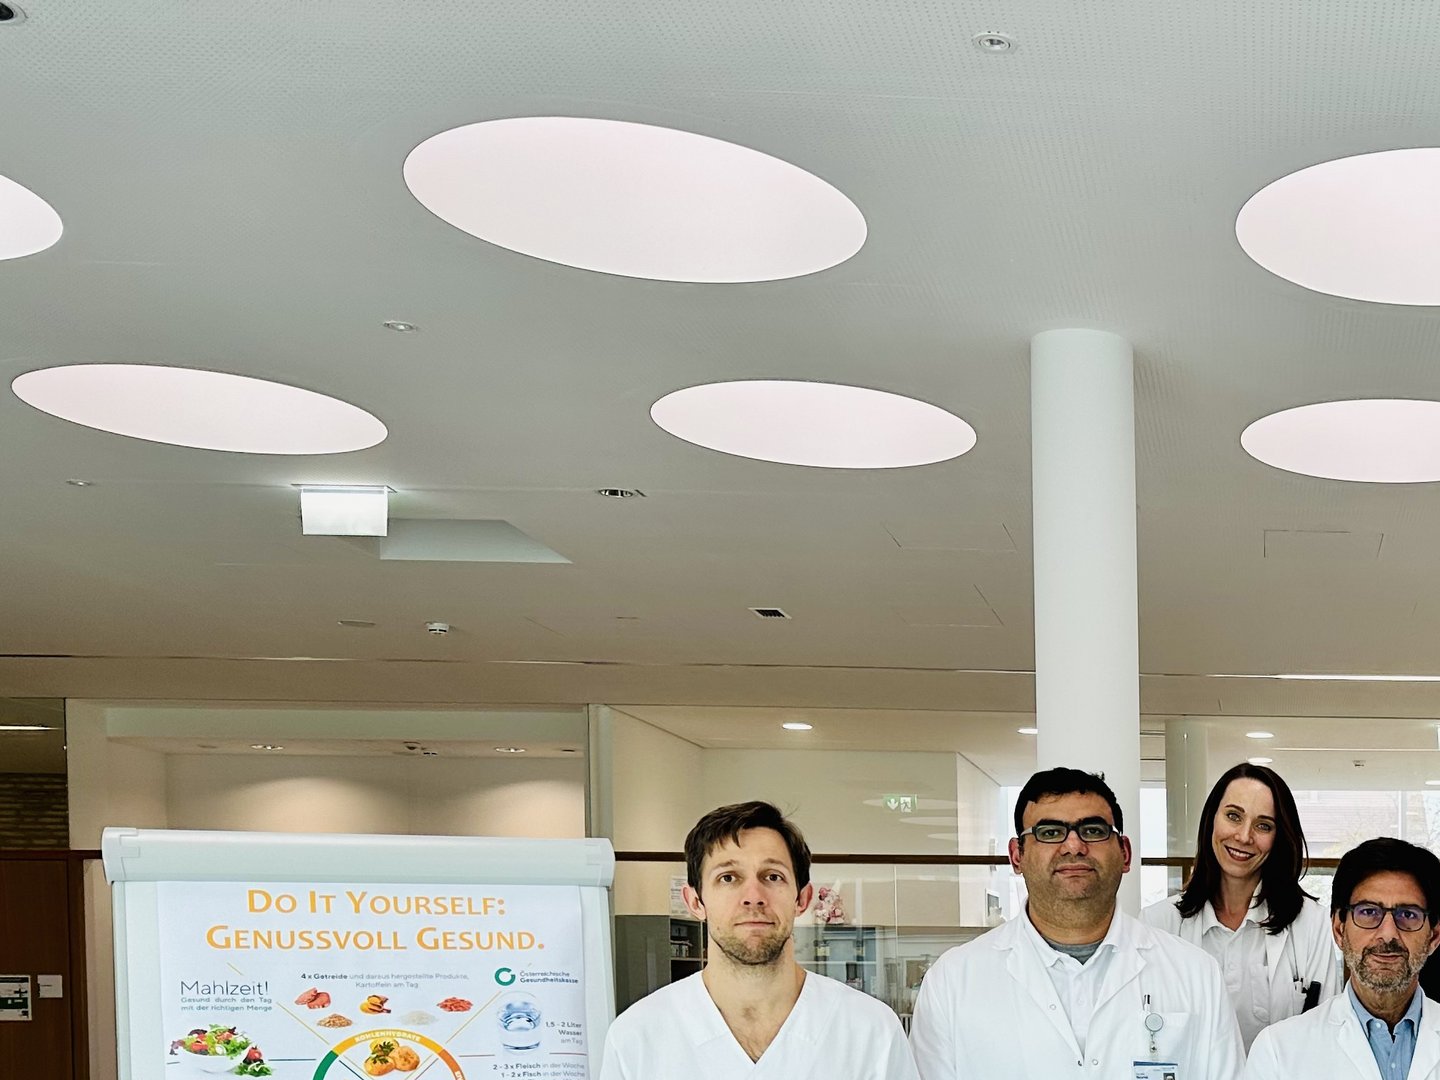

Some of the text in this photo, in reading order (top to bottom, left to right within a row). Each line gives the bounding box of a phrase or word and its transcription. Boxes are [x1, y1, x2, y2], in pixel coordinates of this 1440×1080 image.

[180, 980, 269, 996] Mahlzeit!
[214, 996, 237, 1004] durch
[259, 997, 273, 1005] Tag
[211, 1004, 244, 1012] richtigen
